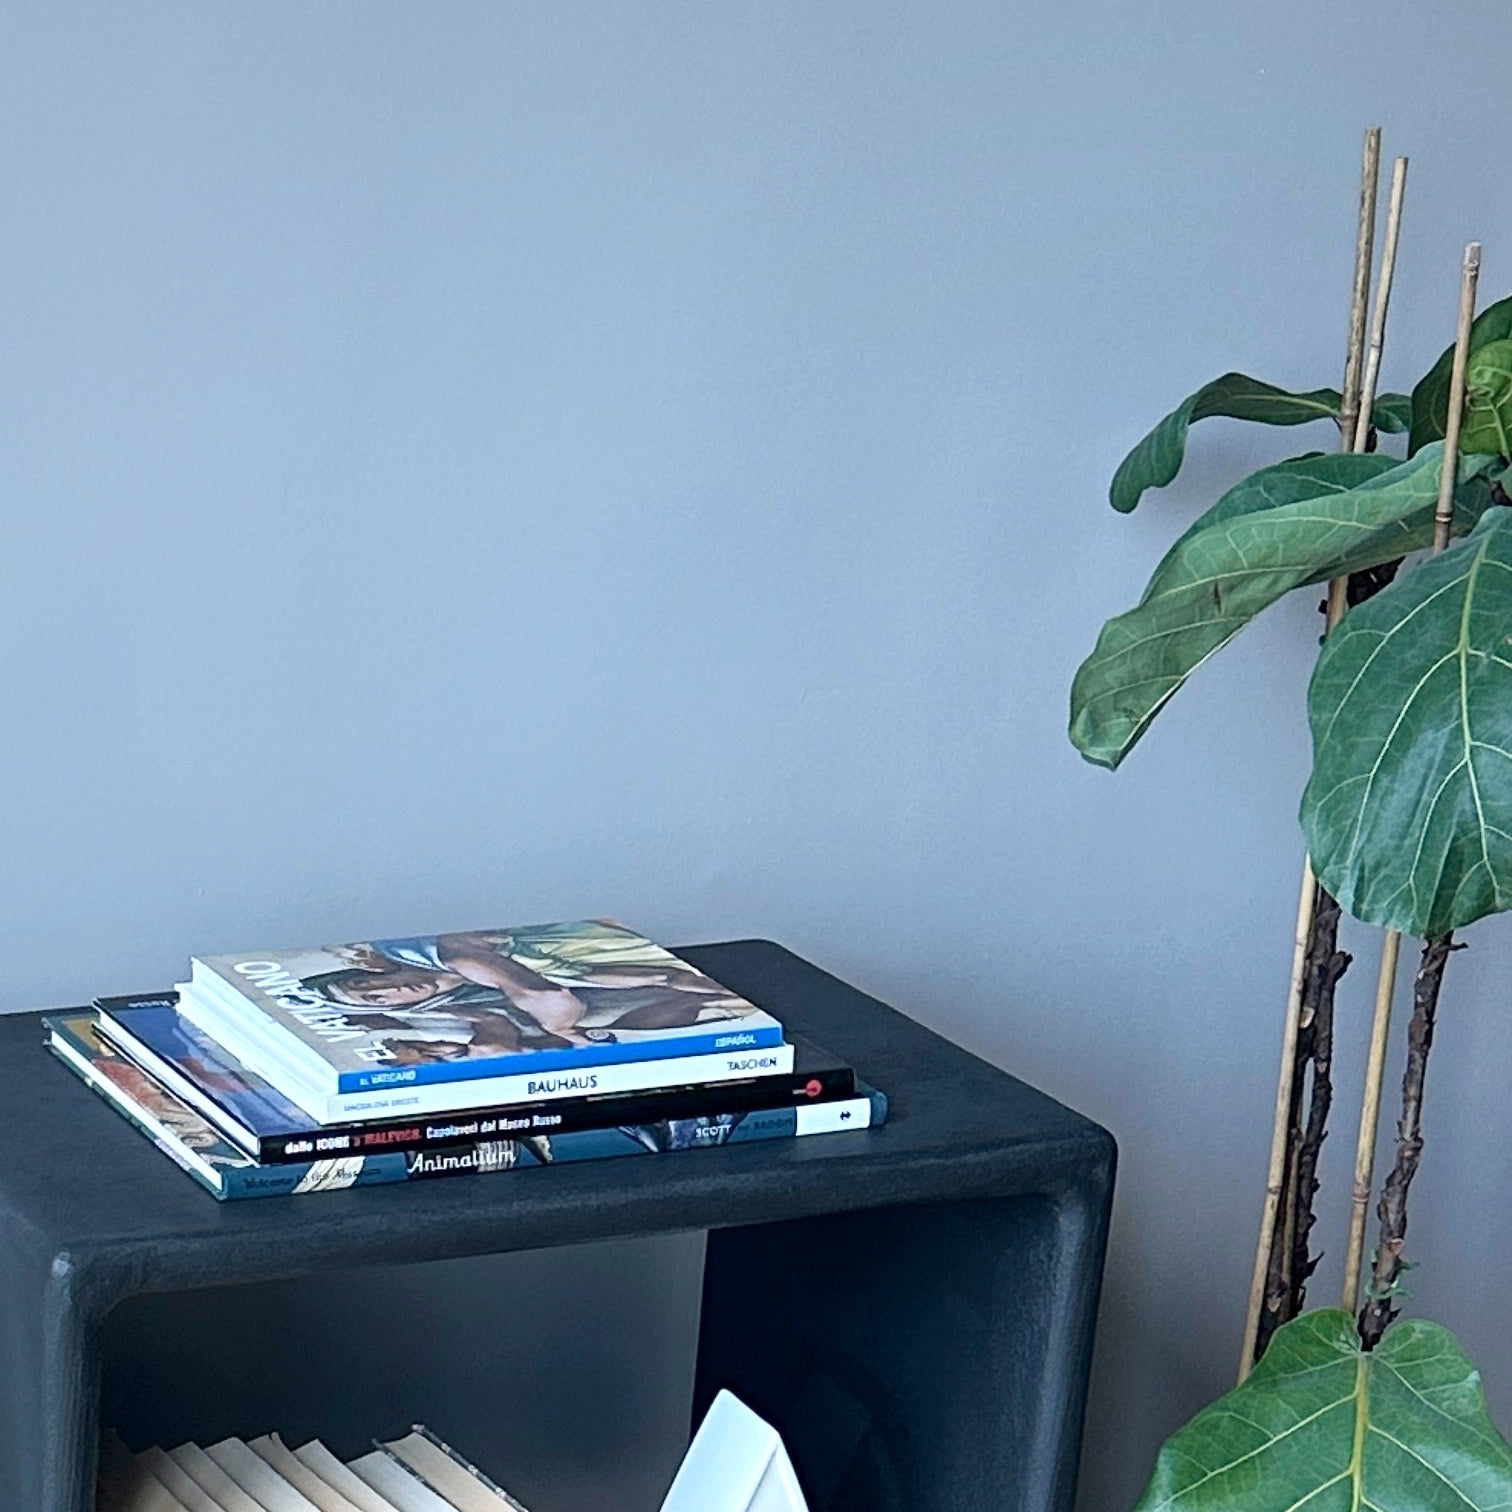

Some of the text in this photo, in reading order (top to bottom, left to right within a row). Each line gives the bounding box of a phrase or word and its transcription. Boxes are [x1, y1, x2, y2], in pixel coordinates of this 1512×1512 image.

[234, 961, 398, 1062] EL VATICANO
[727, 1057, 778, 1071] TASCHEN
[371, 1070, 417, 1085] VATICANO
[527, 1075, 598, 1095] BAUHAUS
[695, 1124, 732, 1139] SCOTT
[408, 1147, 517, 1174] Animalium
